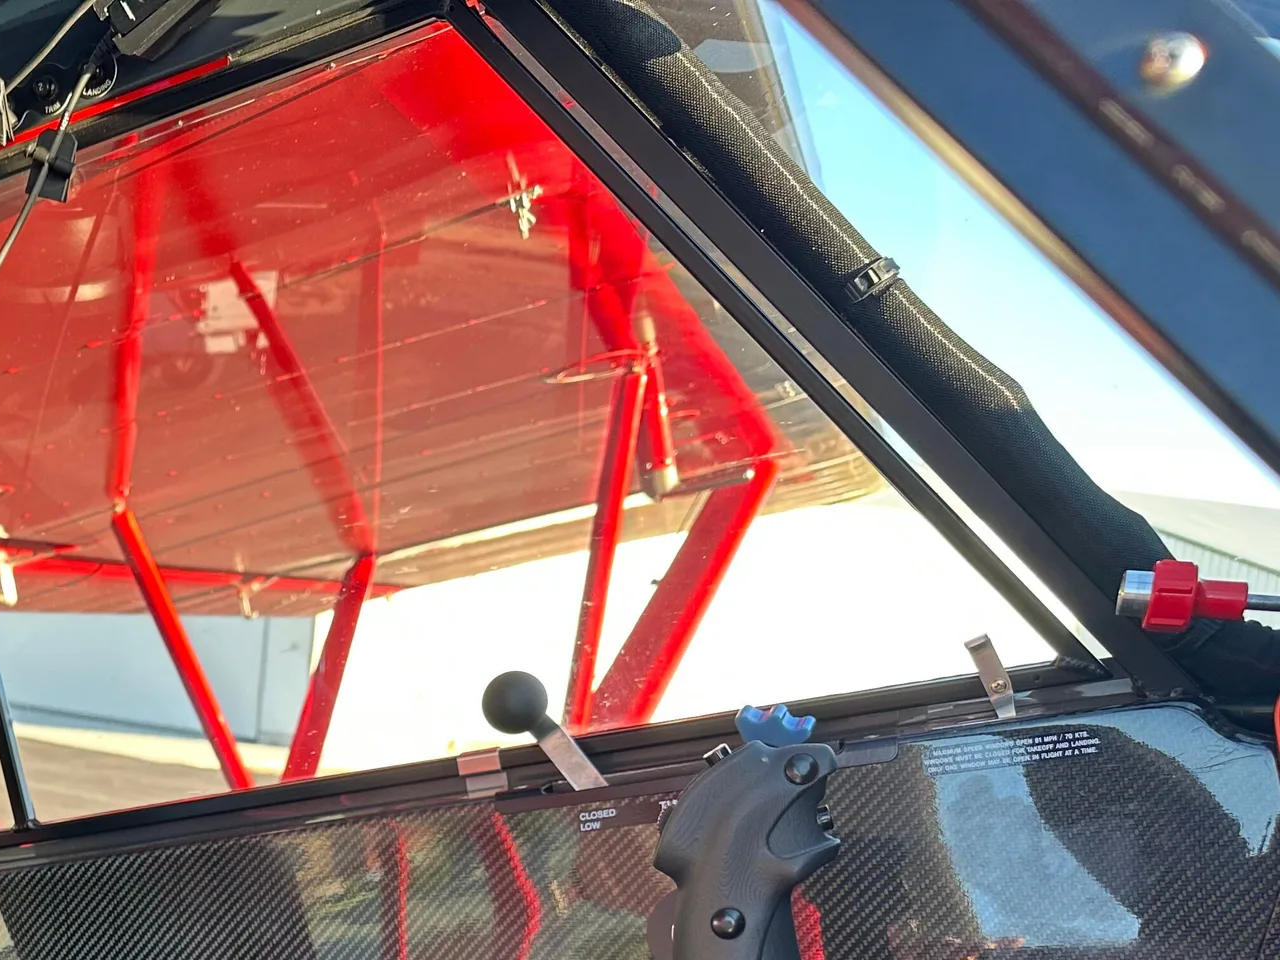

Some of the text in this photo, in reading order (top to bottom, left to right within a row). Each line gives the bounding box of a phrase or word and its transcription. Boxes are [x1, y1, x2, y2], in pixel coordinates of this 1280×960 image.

[83, 80, 112, 97] LANDING
[45, 102, 61, 114] TRIM
[963, 745, 983, 753] SPEED
[1015, 738, 1033, 746] OPEN
[985, 749, 1010, 758] CLOSED
[1012, 747, 1026, 755] FOR
[1027, 744, 1054, 752] TAKEOFF
[960, 761, 986, 769] WINDOW
[987, 758, 1000, 766] MAY
[1013, 755, 1031, 763] OPEN
[1041, 750, 1063, 759] FLIGHT
[579, 809, 616, 821] CLOSED
[580, 821, 600, 831] LOW
